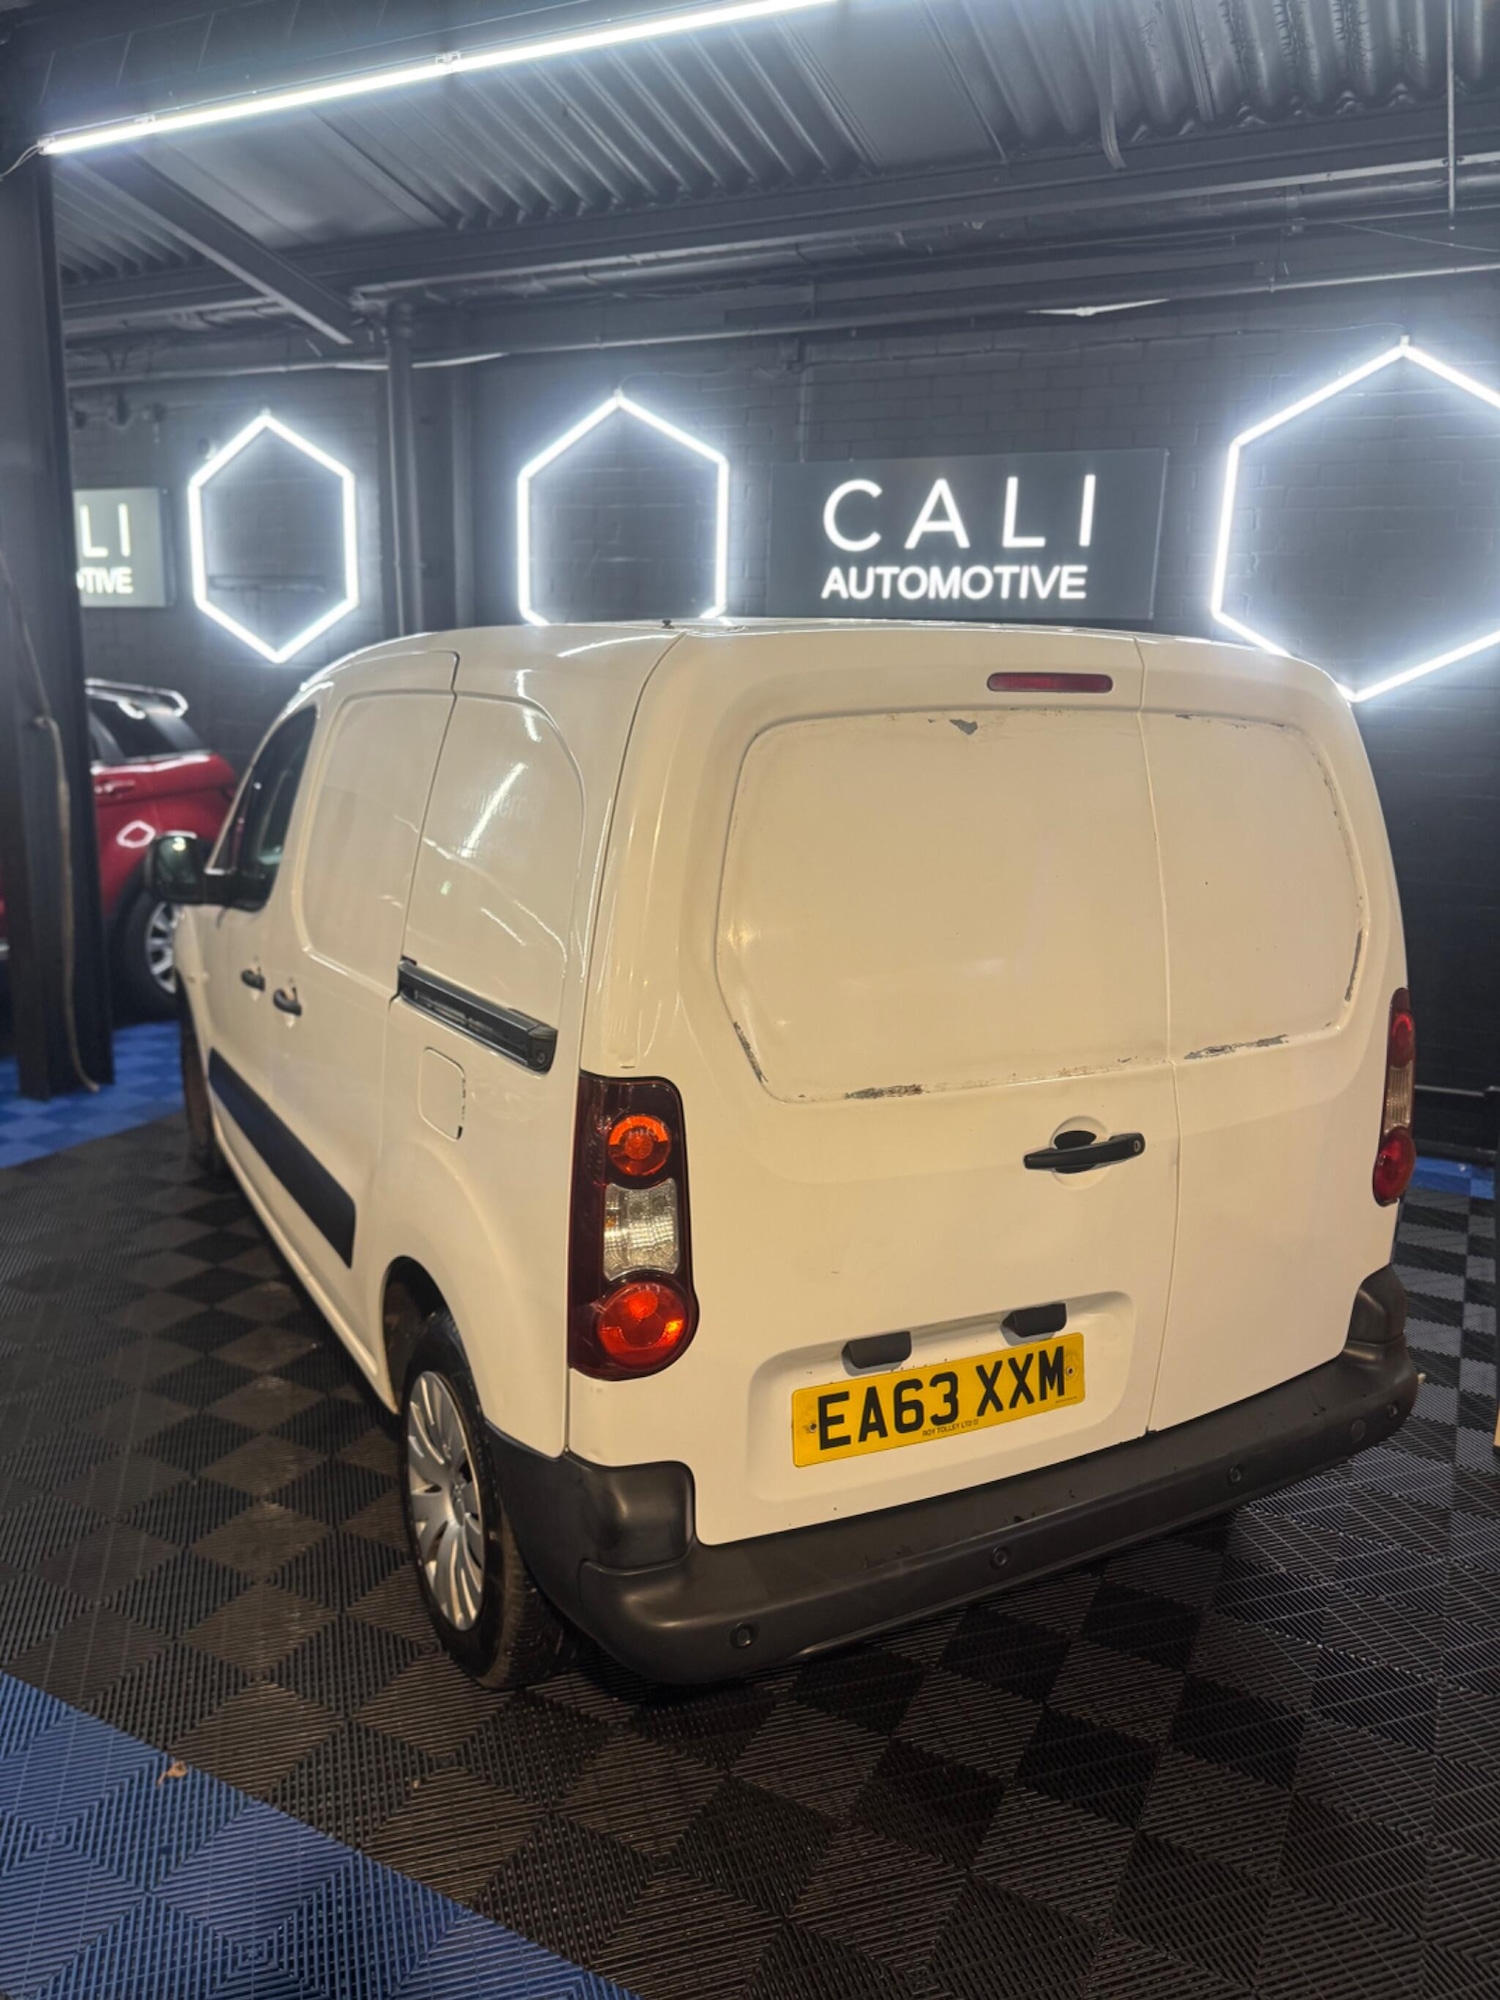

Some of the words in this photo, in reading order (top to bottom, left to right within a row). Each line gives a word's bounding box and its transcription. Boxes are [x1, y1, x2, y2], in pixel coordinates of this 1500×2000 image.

[823, 474, 1097, 552] CALI
[821, 565, 1089, 600] AUTOMOTIVE
[817, 1371, 959, 1451] EA63
[975, 1346, 1066, 1418] XXM
